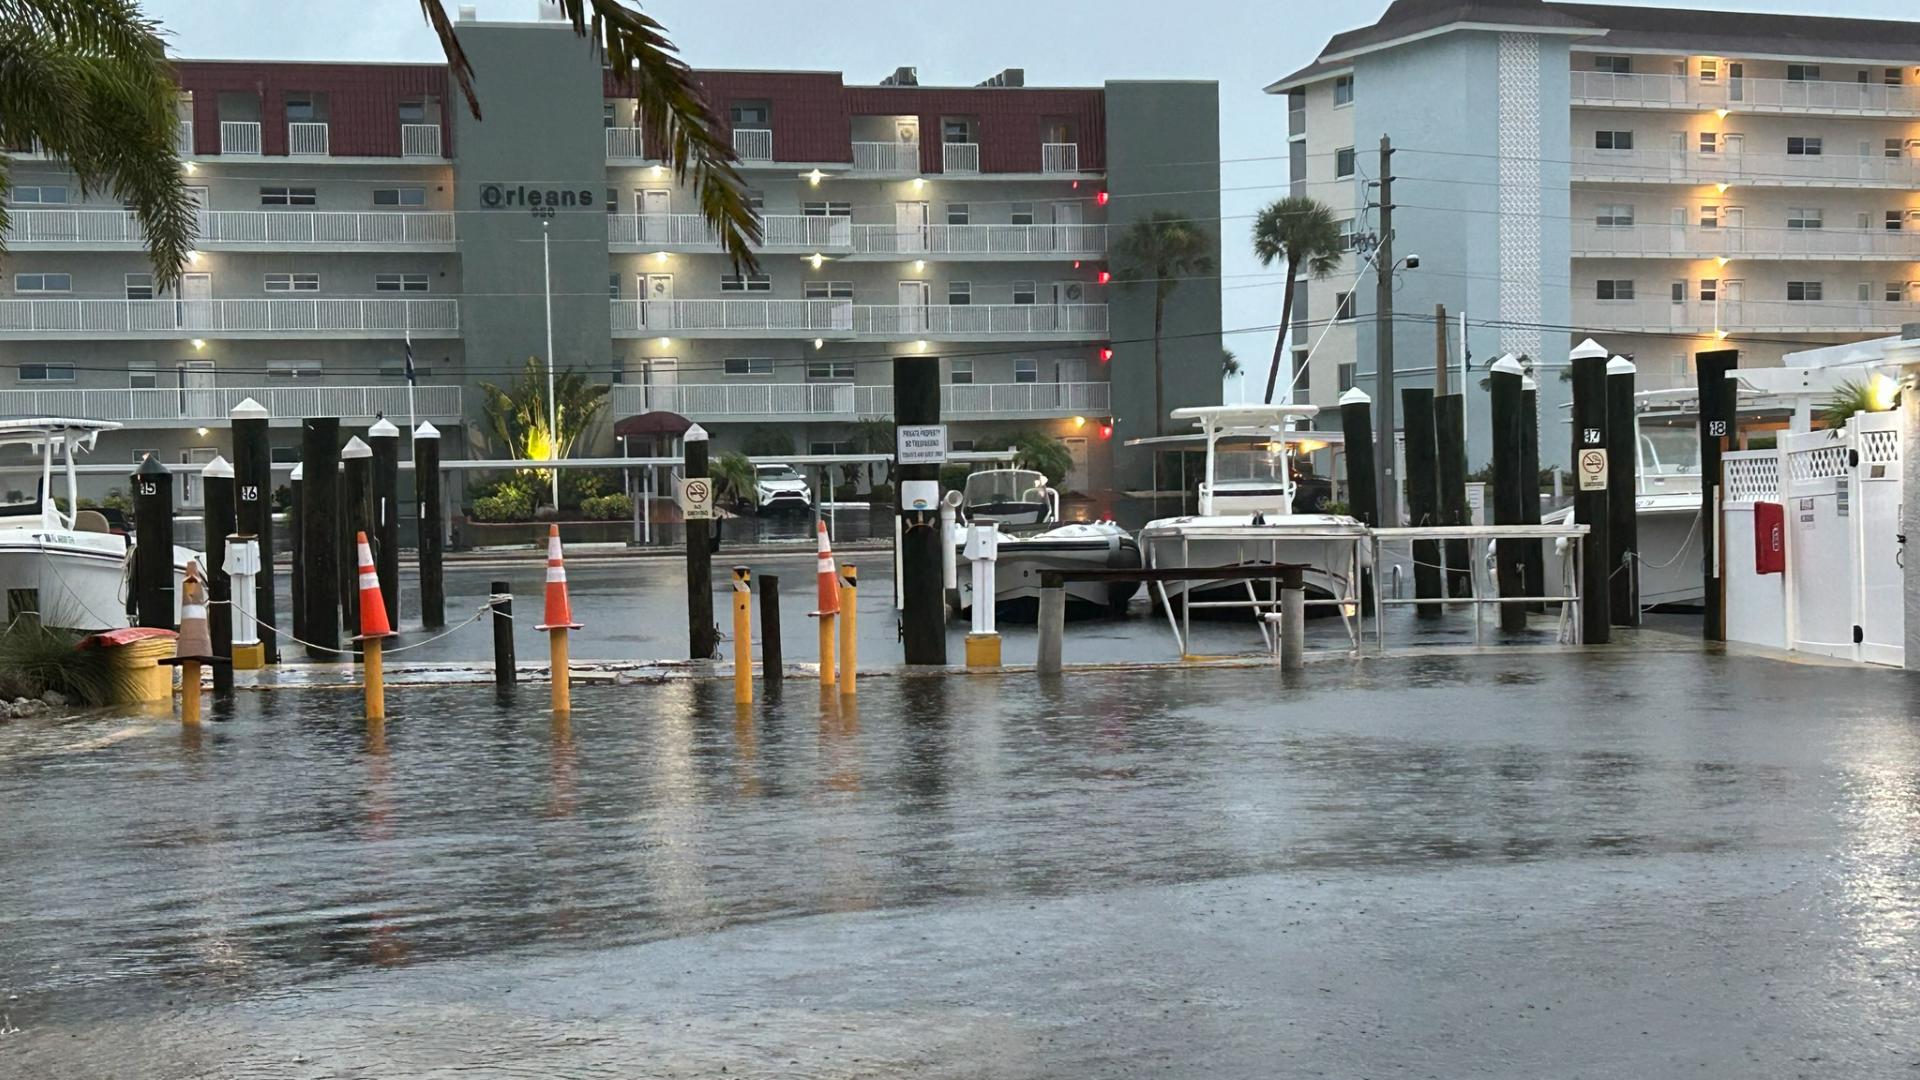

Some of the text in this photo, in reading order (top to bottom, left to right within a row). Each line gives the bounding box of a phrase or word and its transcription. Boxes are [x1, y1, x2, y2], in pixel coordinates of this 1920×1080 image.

[482, 185, 593, 206] Orleans
[1710, 421, 1726, 435] 18
[141, 482, 156, 495] 15
[242, 486, 257, 500] 16
